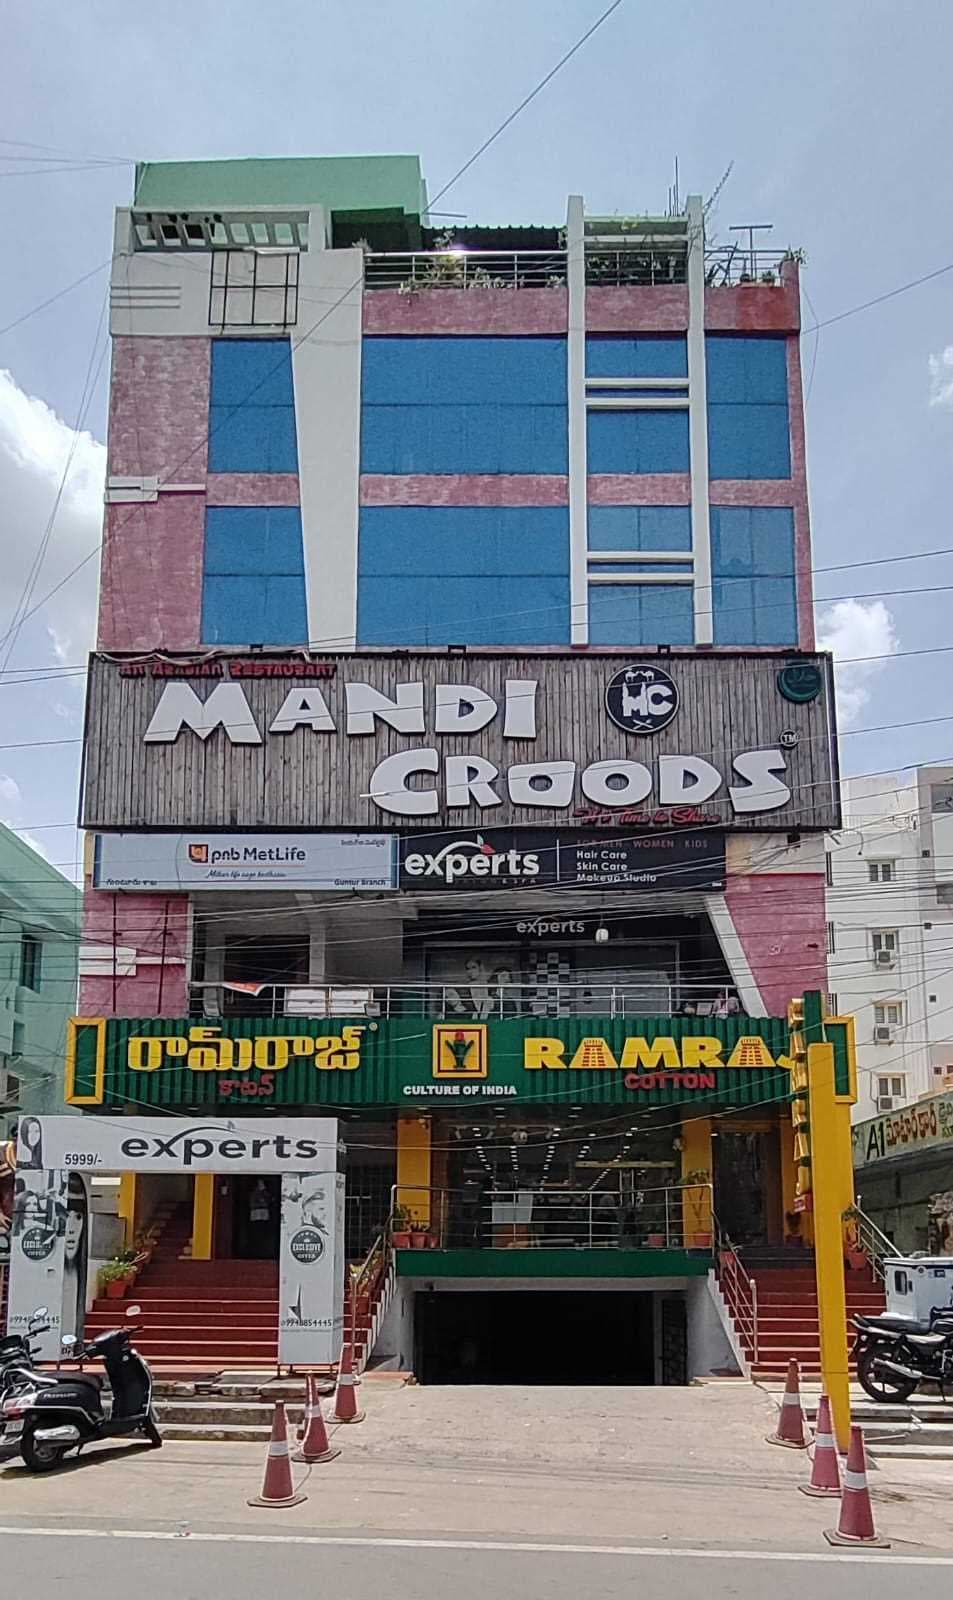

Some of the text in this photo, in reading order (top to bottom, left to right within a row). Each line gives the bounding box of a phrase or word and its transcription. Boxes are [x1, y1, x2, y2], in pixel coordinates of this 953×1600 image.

[622, 682, 674, 717] MC
[143, 681, 538, 744] MANDI
[368, 747, 792, 815] CROODS
[633, 839, 674, 849] WOMEN
[685, 839, 709, 849] KIDS
[211, 846, 306, 864] pnb MetLife
[576, 850, 628, 860] Hair Care
[404, 849, 540, 883] experts
[576, 861, 628, 871] Skin Care
[361, 878, 386, 886] Branch
[576, 872, 657, 884] Makeup Studio
[516, 918, 585, 936] experts
[403, 1085, 518, 1095] CULTURE OF INDIA
[624, 1073, 717, 1090] COTTON
[120, 1133, 318, 1166] experts
[64, 1153, 102, 1167] 5999/-
